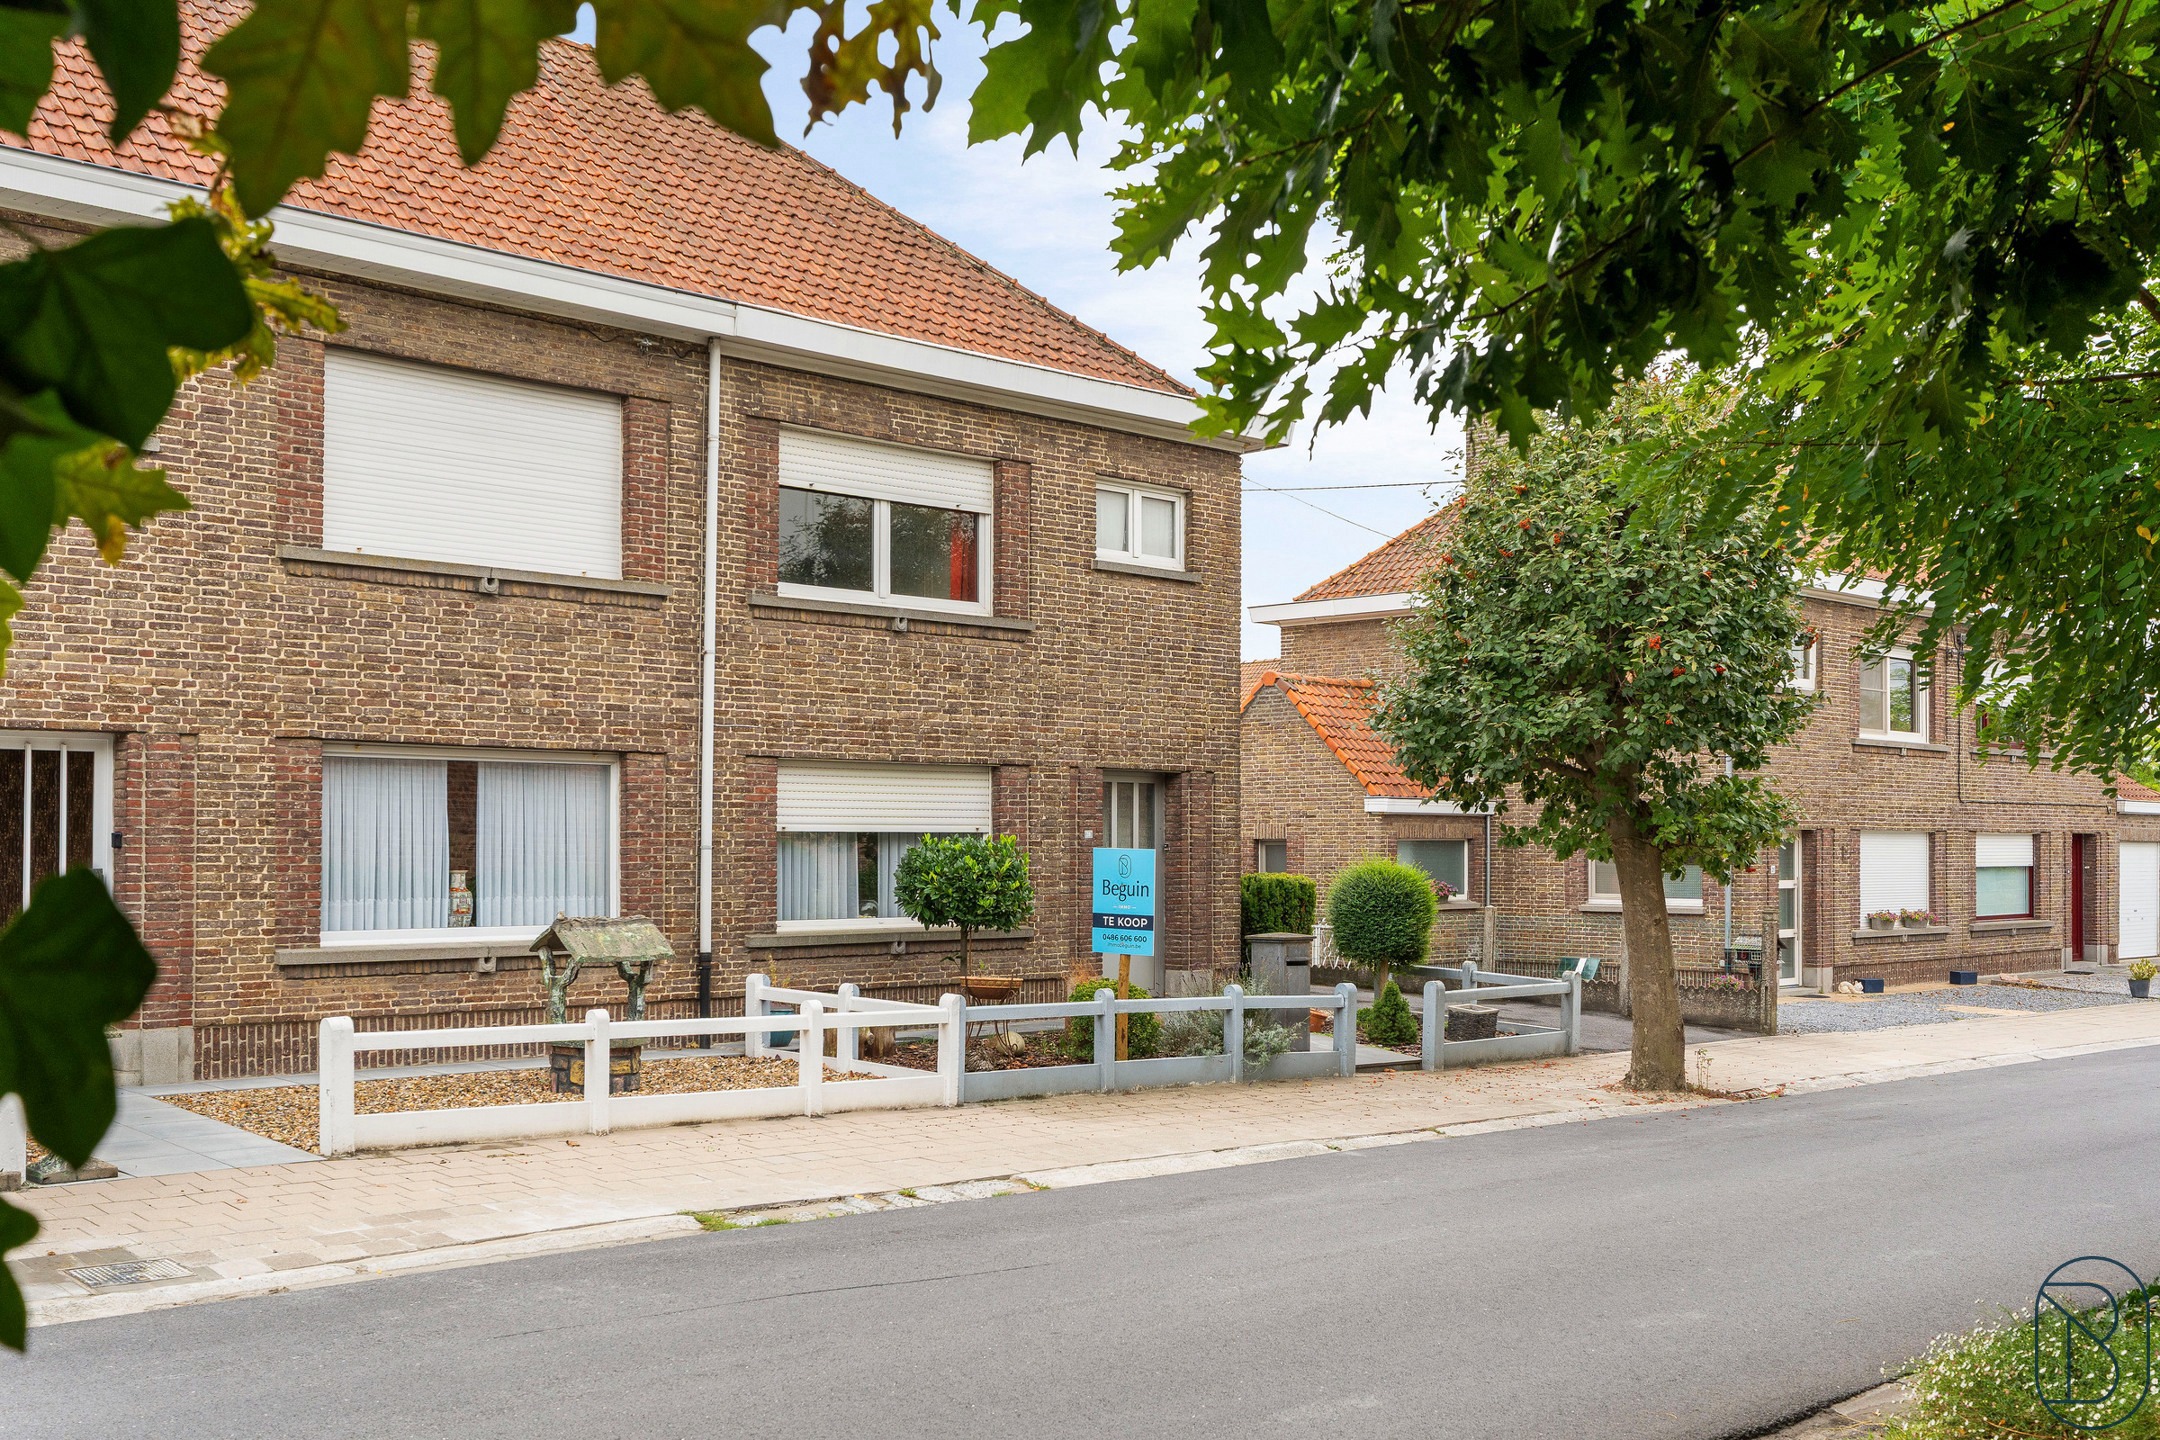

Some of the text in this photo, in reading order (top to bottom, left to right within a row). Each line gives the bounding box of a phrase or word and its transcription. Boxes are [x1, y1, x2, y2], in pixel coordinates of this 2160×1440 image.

[1102, 879, 1150, 902] Beguin
[1102, 916, 1148, 928] TE KOOP
[1102, 933, 1148, 943] 0486 606 600
